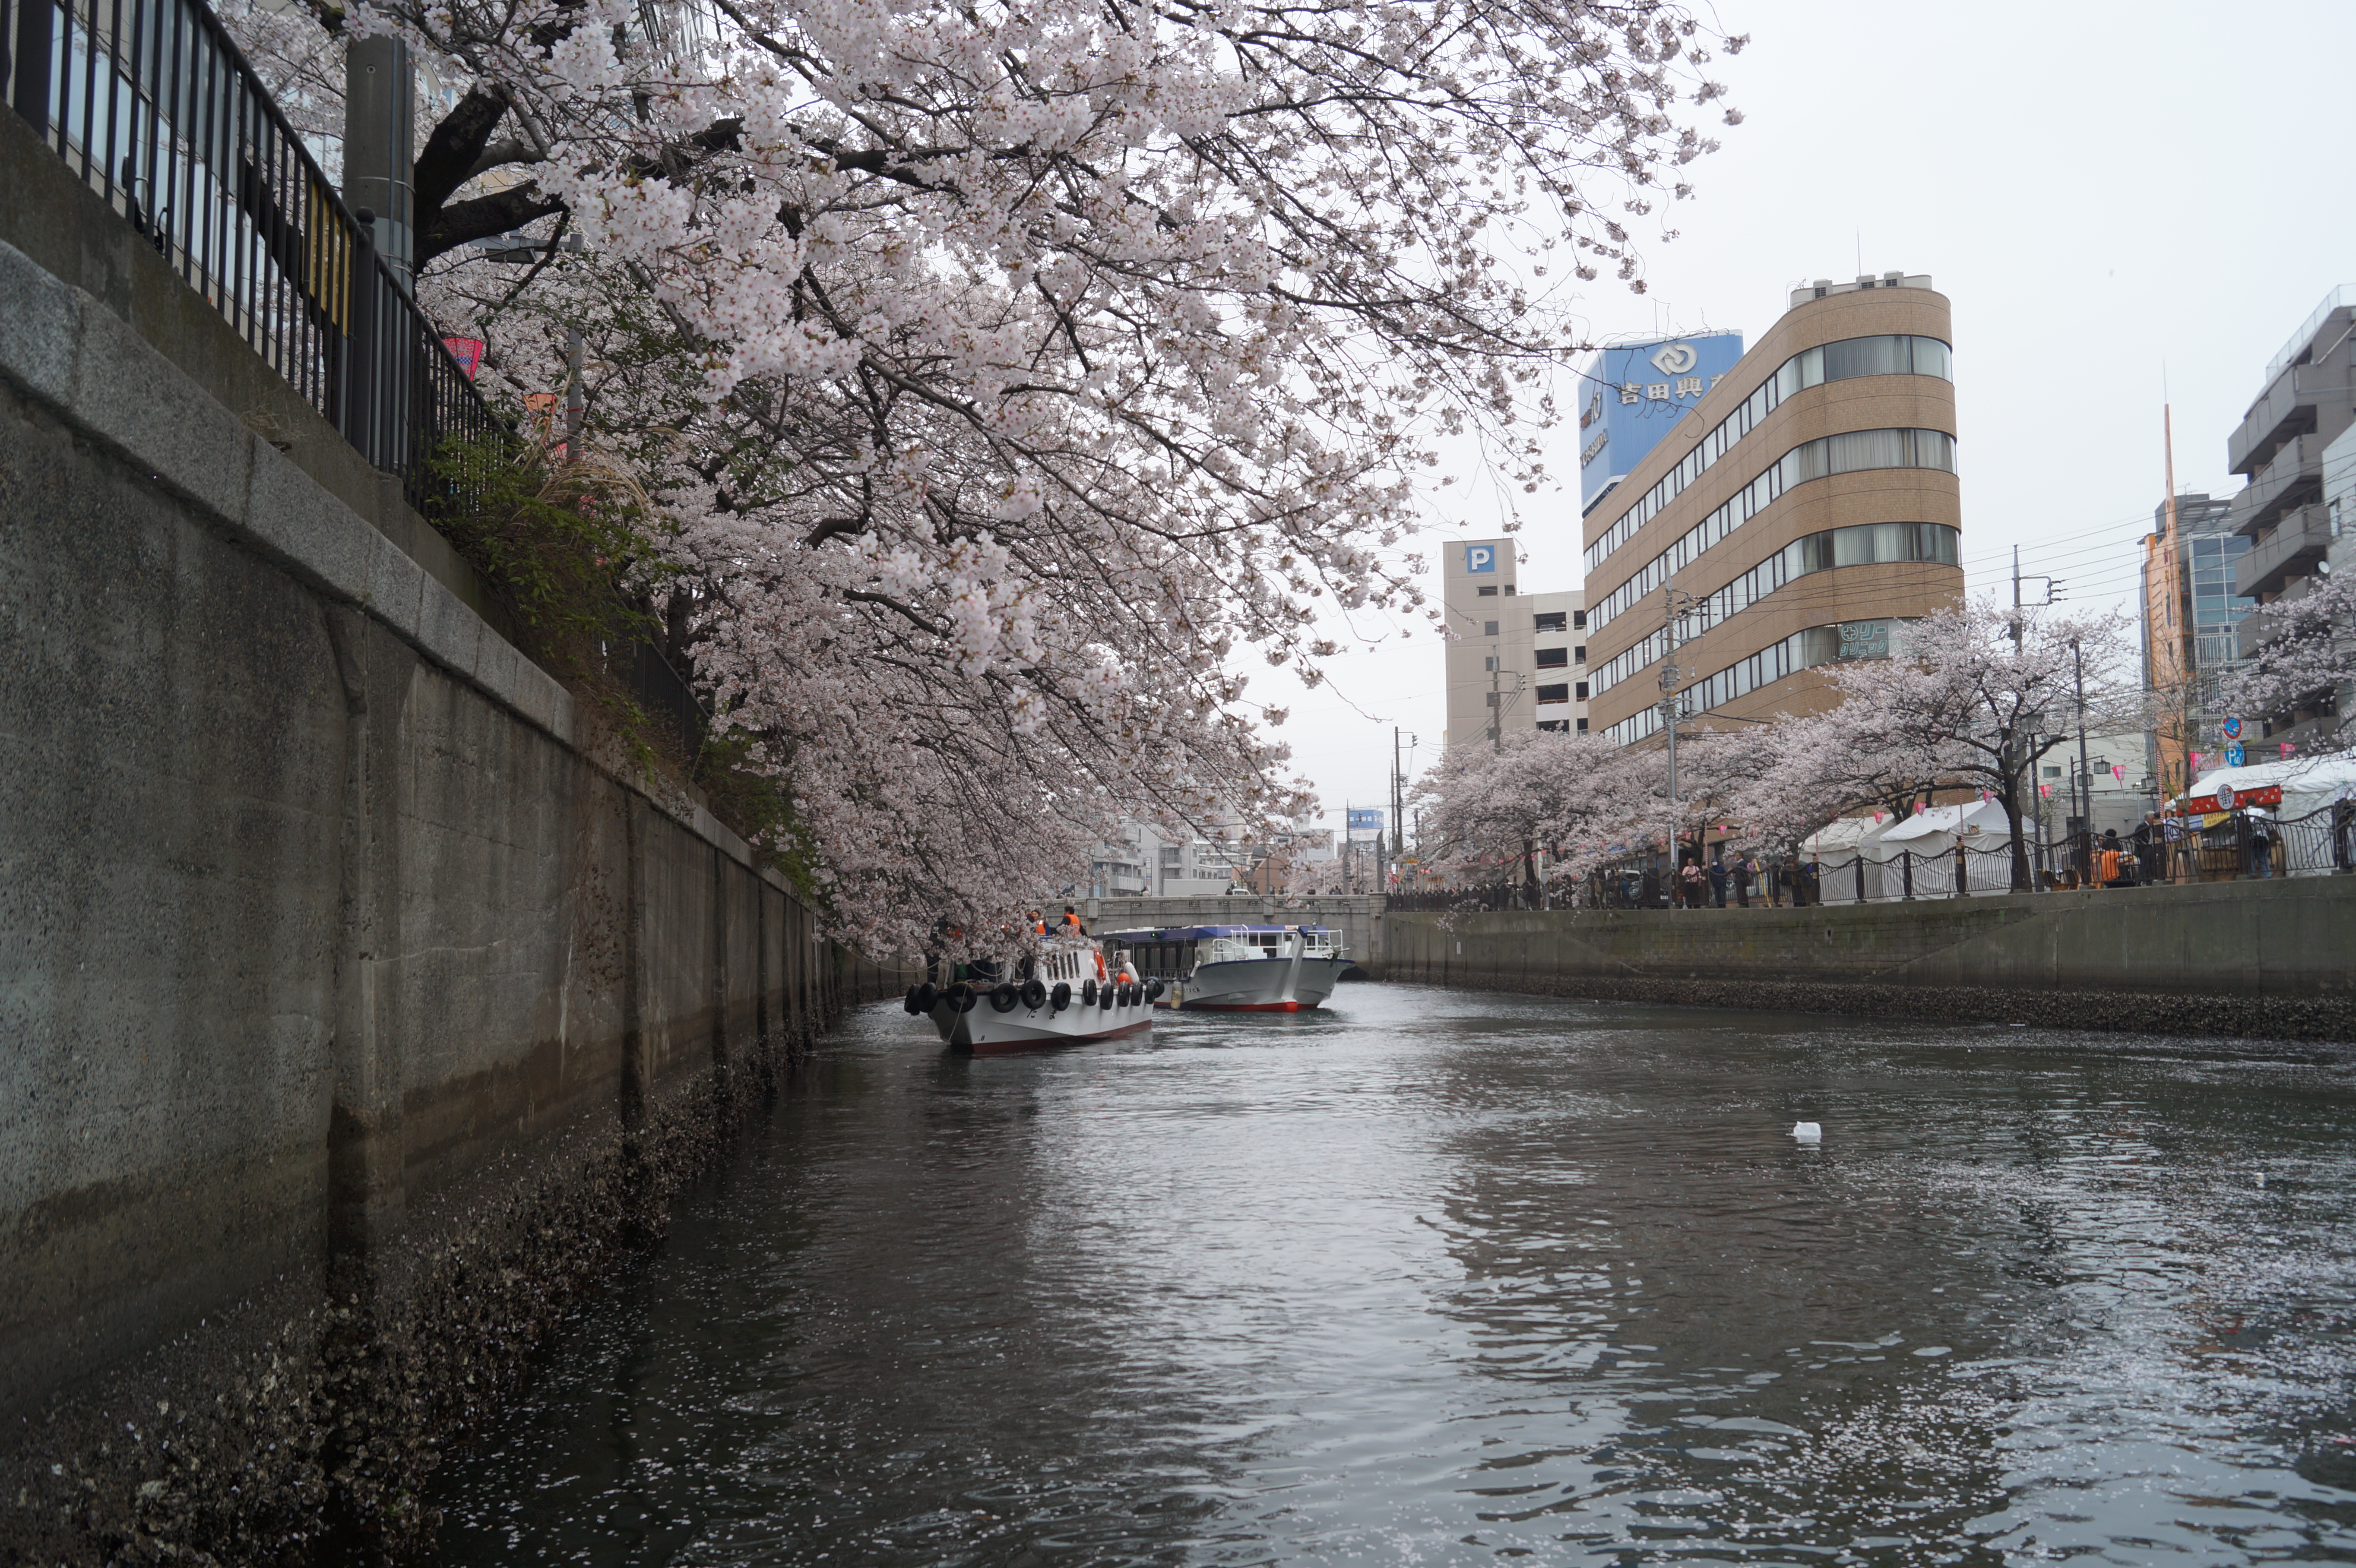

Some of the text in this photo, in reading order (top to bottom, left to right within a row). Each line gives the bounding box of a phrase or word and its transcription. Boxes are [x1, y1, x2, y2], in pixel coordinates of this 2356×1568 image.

[1580, 428, 1609, 470] YOSHIDA
[1471, 548, 1490, 570] P
[1860, 623, 1887, 641] リー
[1840, 639, 1887, 657] クリニック
[2228, 748, 2240, 764] P 60
